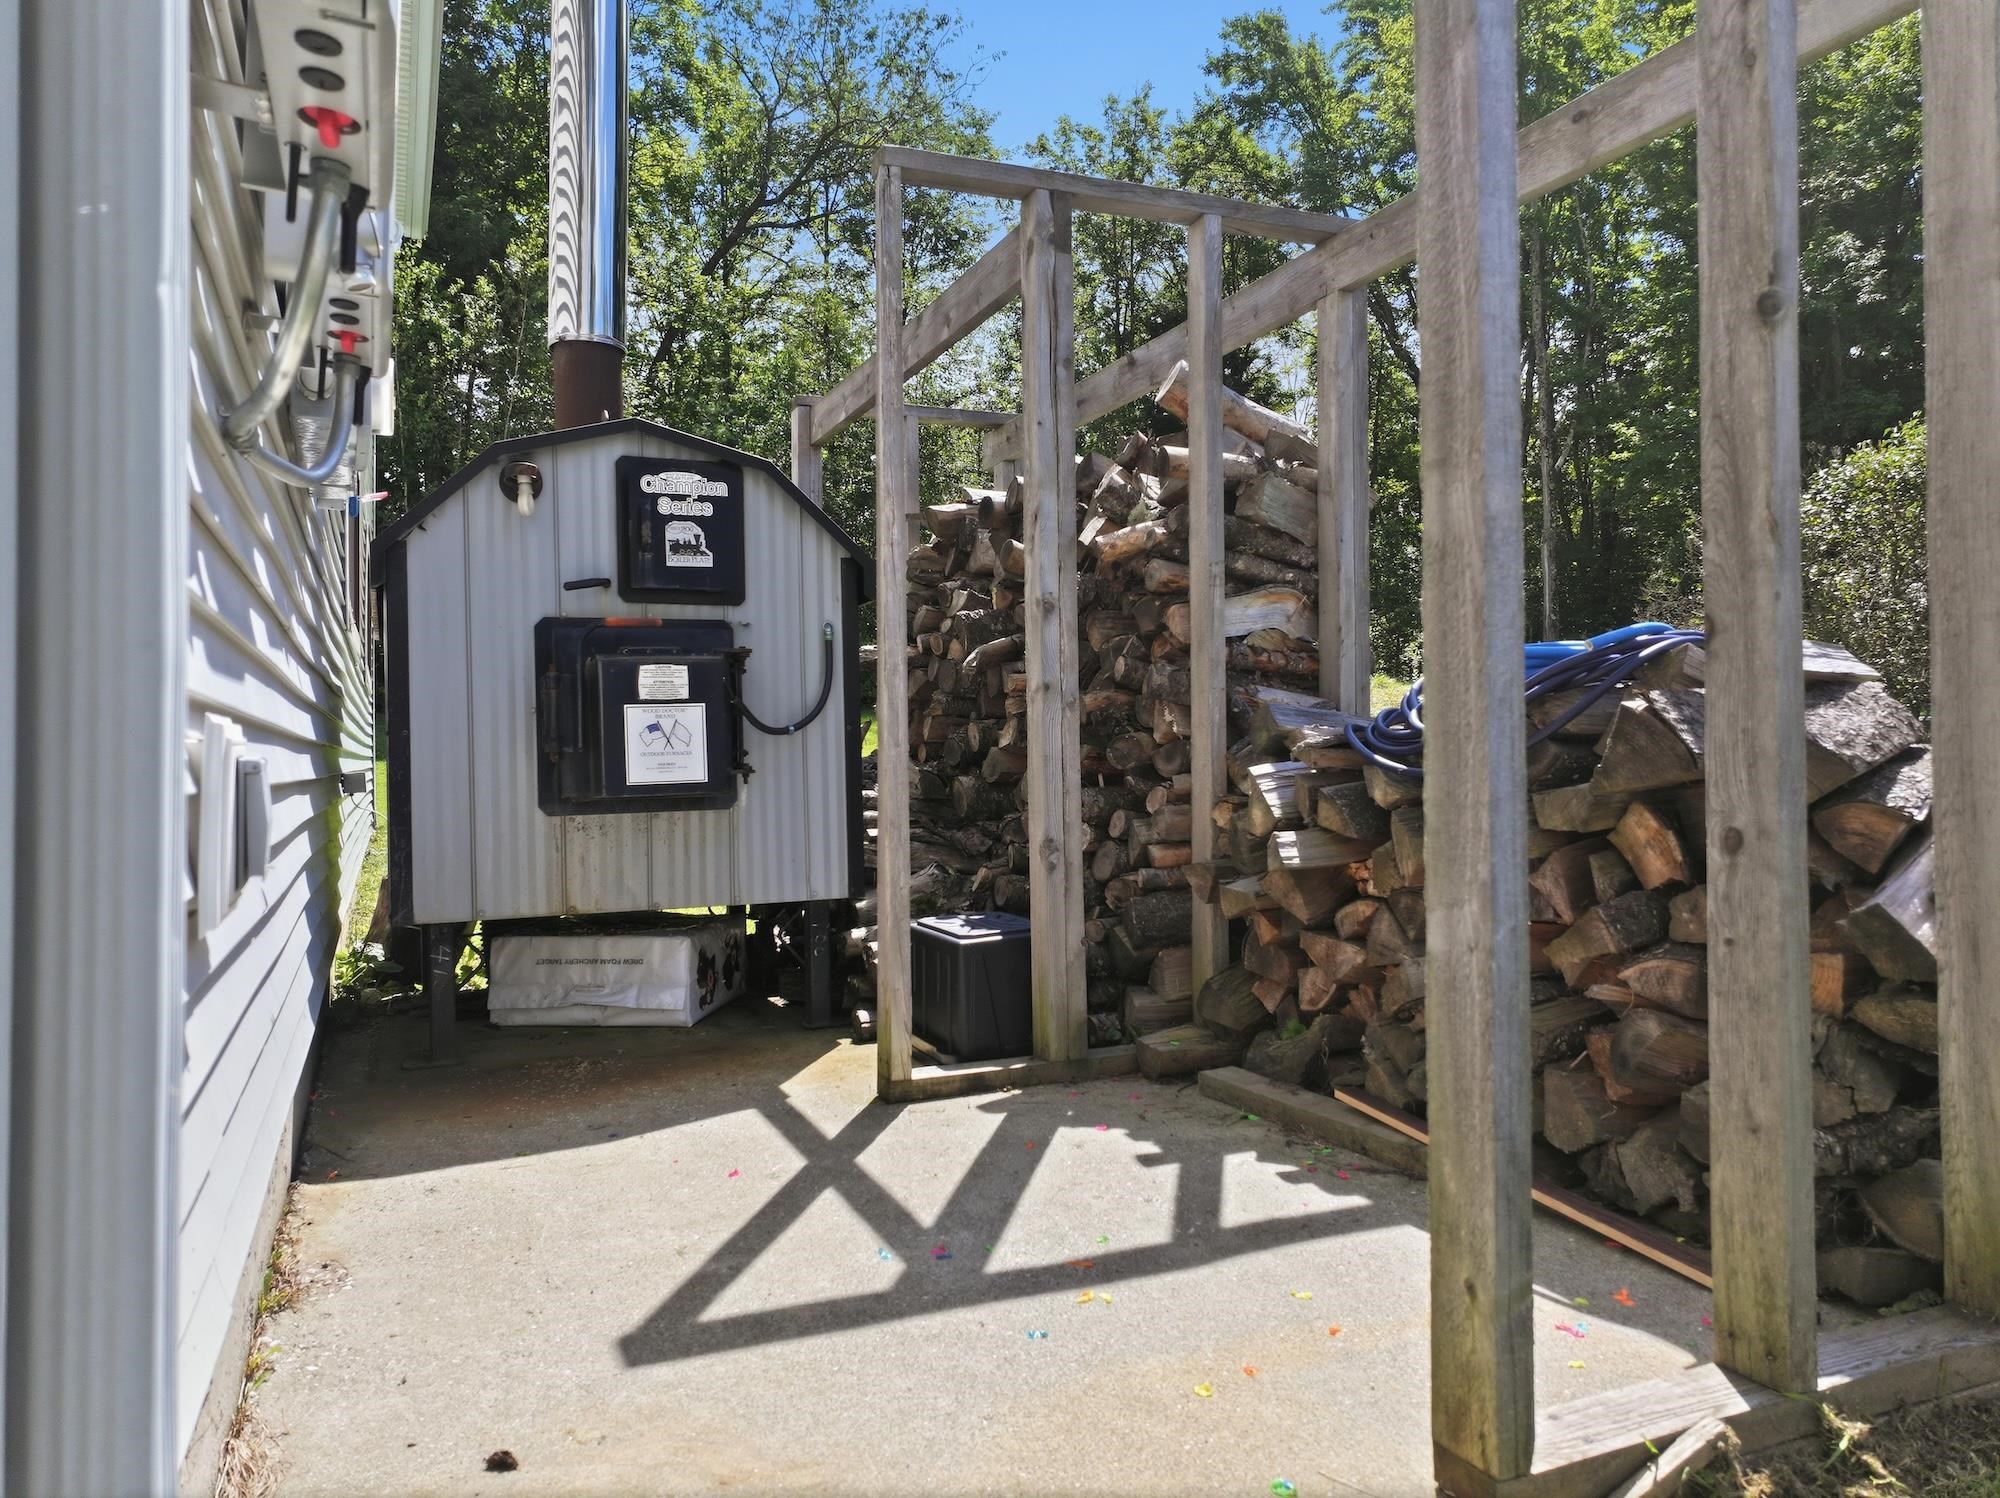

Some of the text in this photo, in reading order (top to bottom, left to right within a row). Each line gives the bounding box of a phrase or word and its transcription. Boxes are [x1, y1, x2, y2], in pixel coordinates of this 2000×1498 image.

[640, 474, 729, 499] Champion
[657, 496, 713, 517] Series
[535, 958, 644, 966] DREW FOAM ARCHERY TARGET
